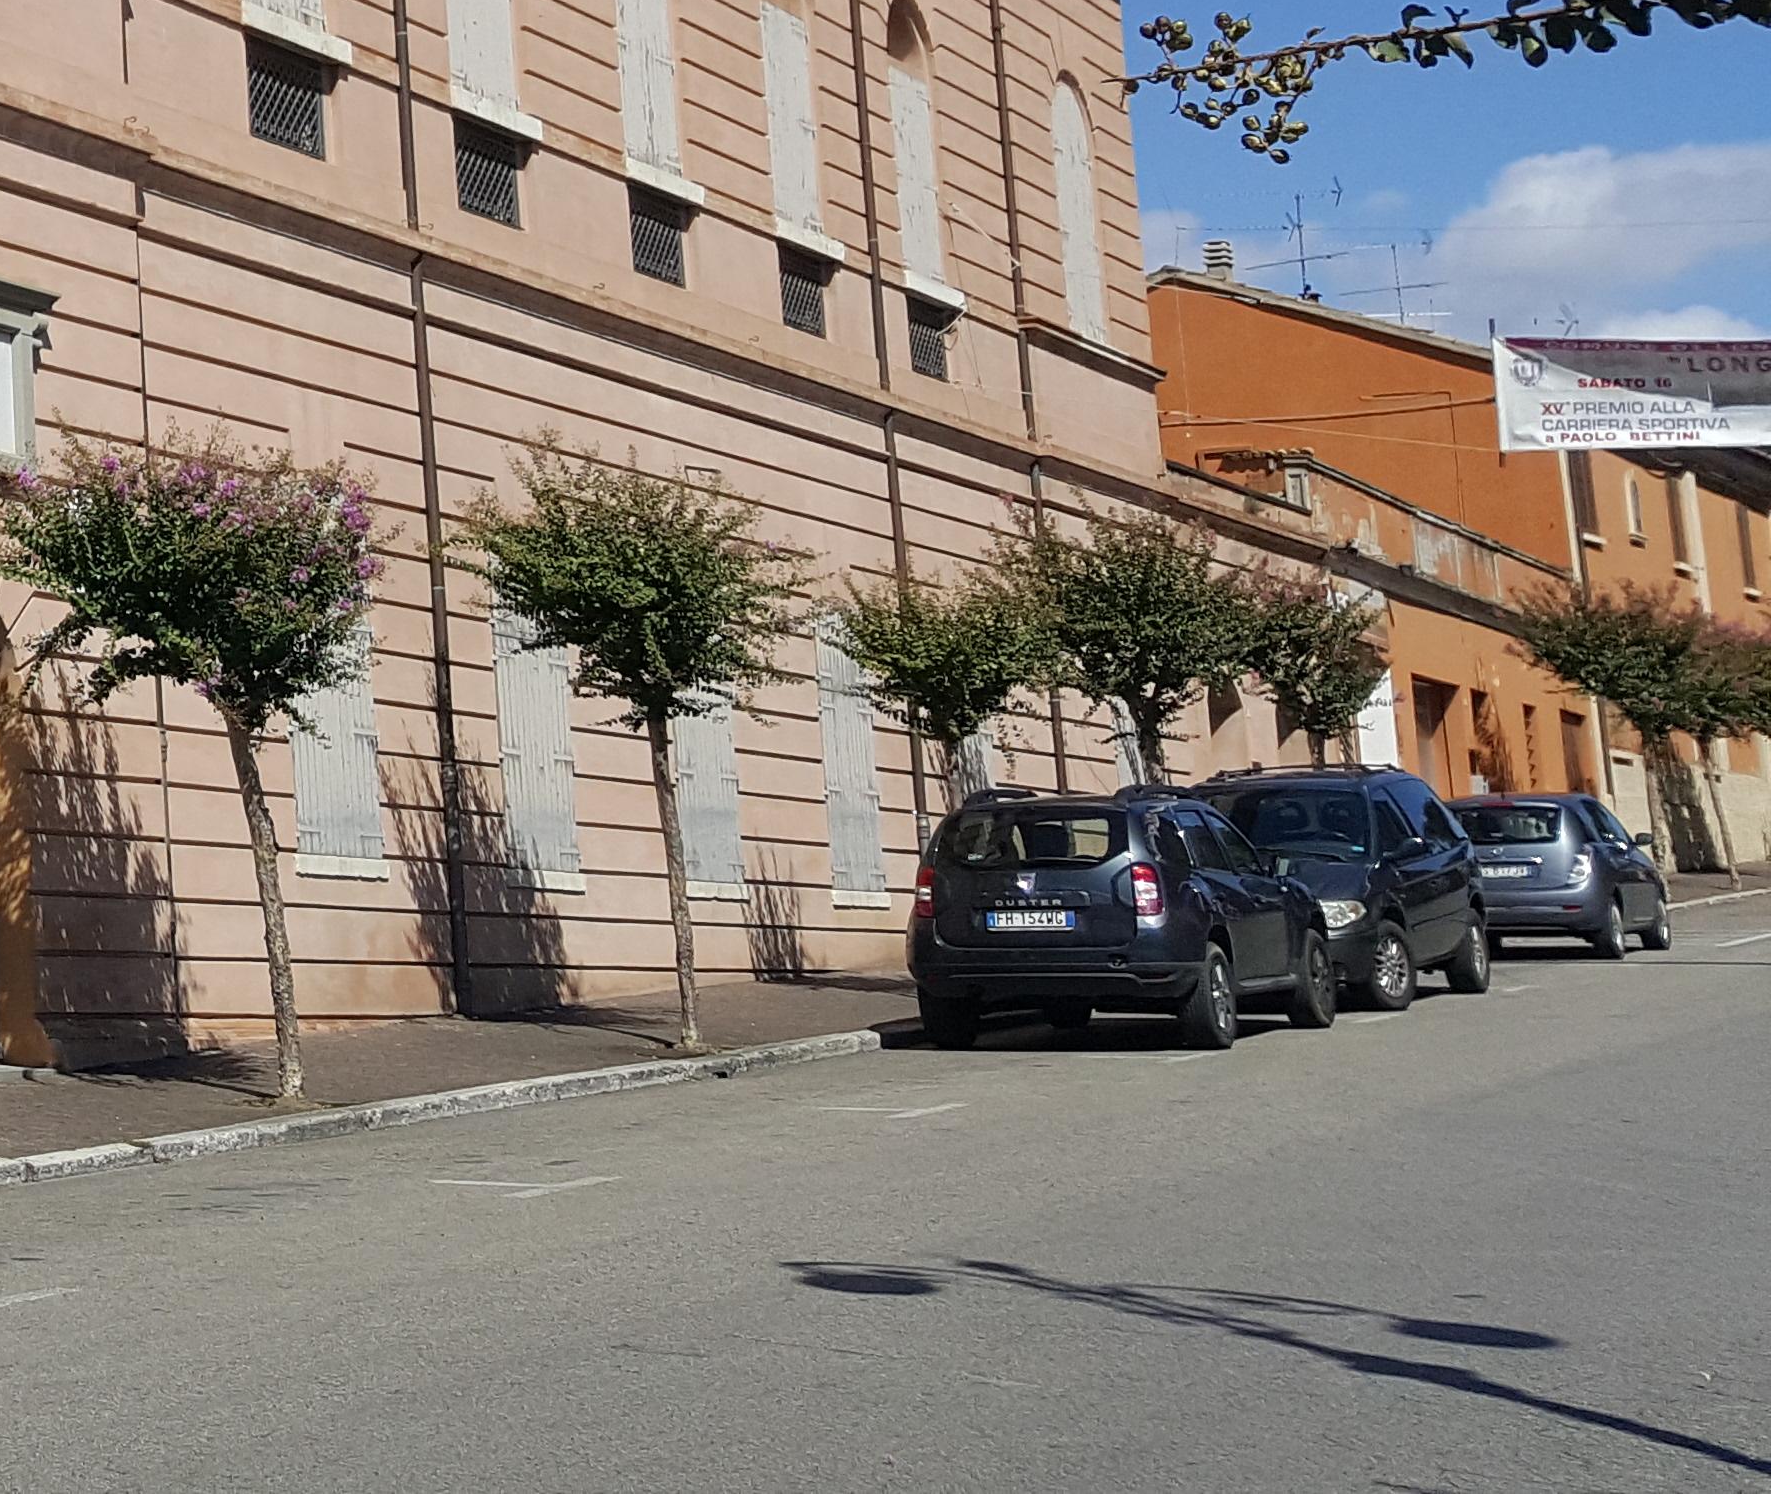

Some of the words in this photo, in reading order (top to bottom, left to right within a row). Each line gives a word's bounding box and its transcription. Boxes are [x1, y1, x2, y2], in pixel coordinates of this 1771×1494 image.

[1577, 377, 1646, 388] SABATO
[1573, 401, 1644, 414] PREMIO
[1650, 401, 1695, 414] ALLA
[1541, 418, 1632, 431] CARRIERA
[1638, 417, 1730, 430] SPORTIVA
[1560, 432, 1616, 443] PAOLO
[1629, 431, 1700, 442] BETTINI
[994, 898, 1062, 906] DUSTER
